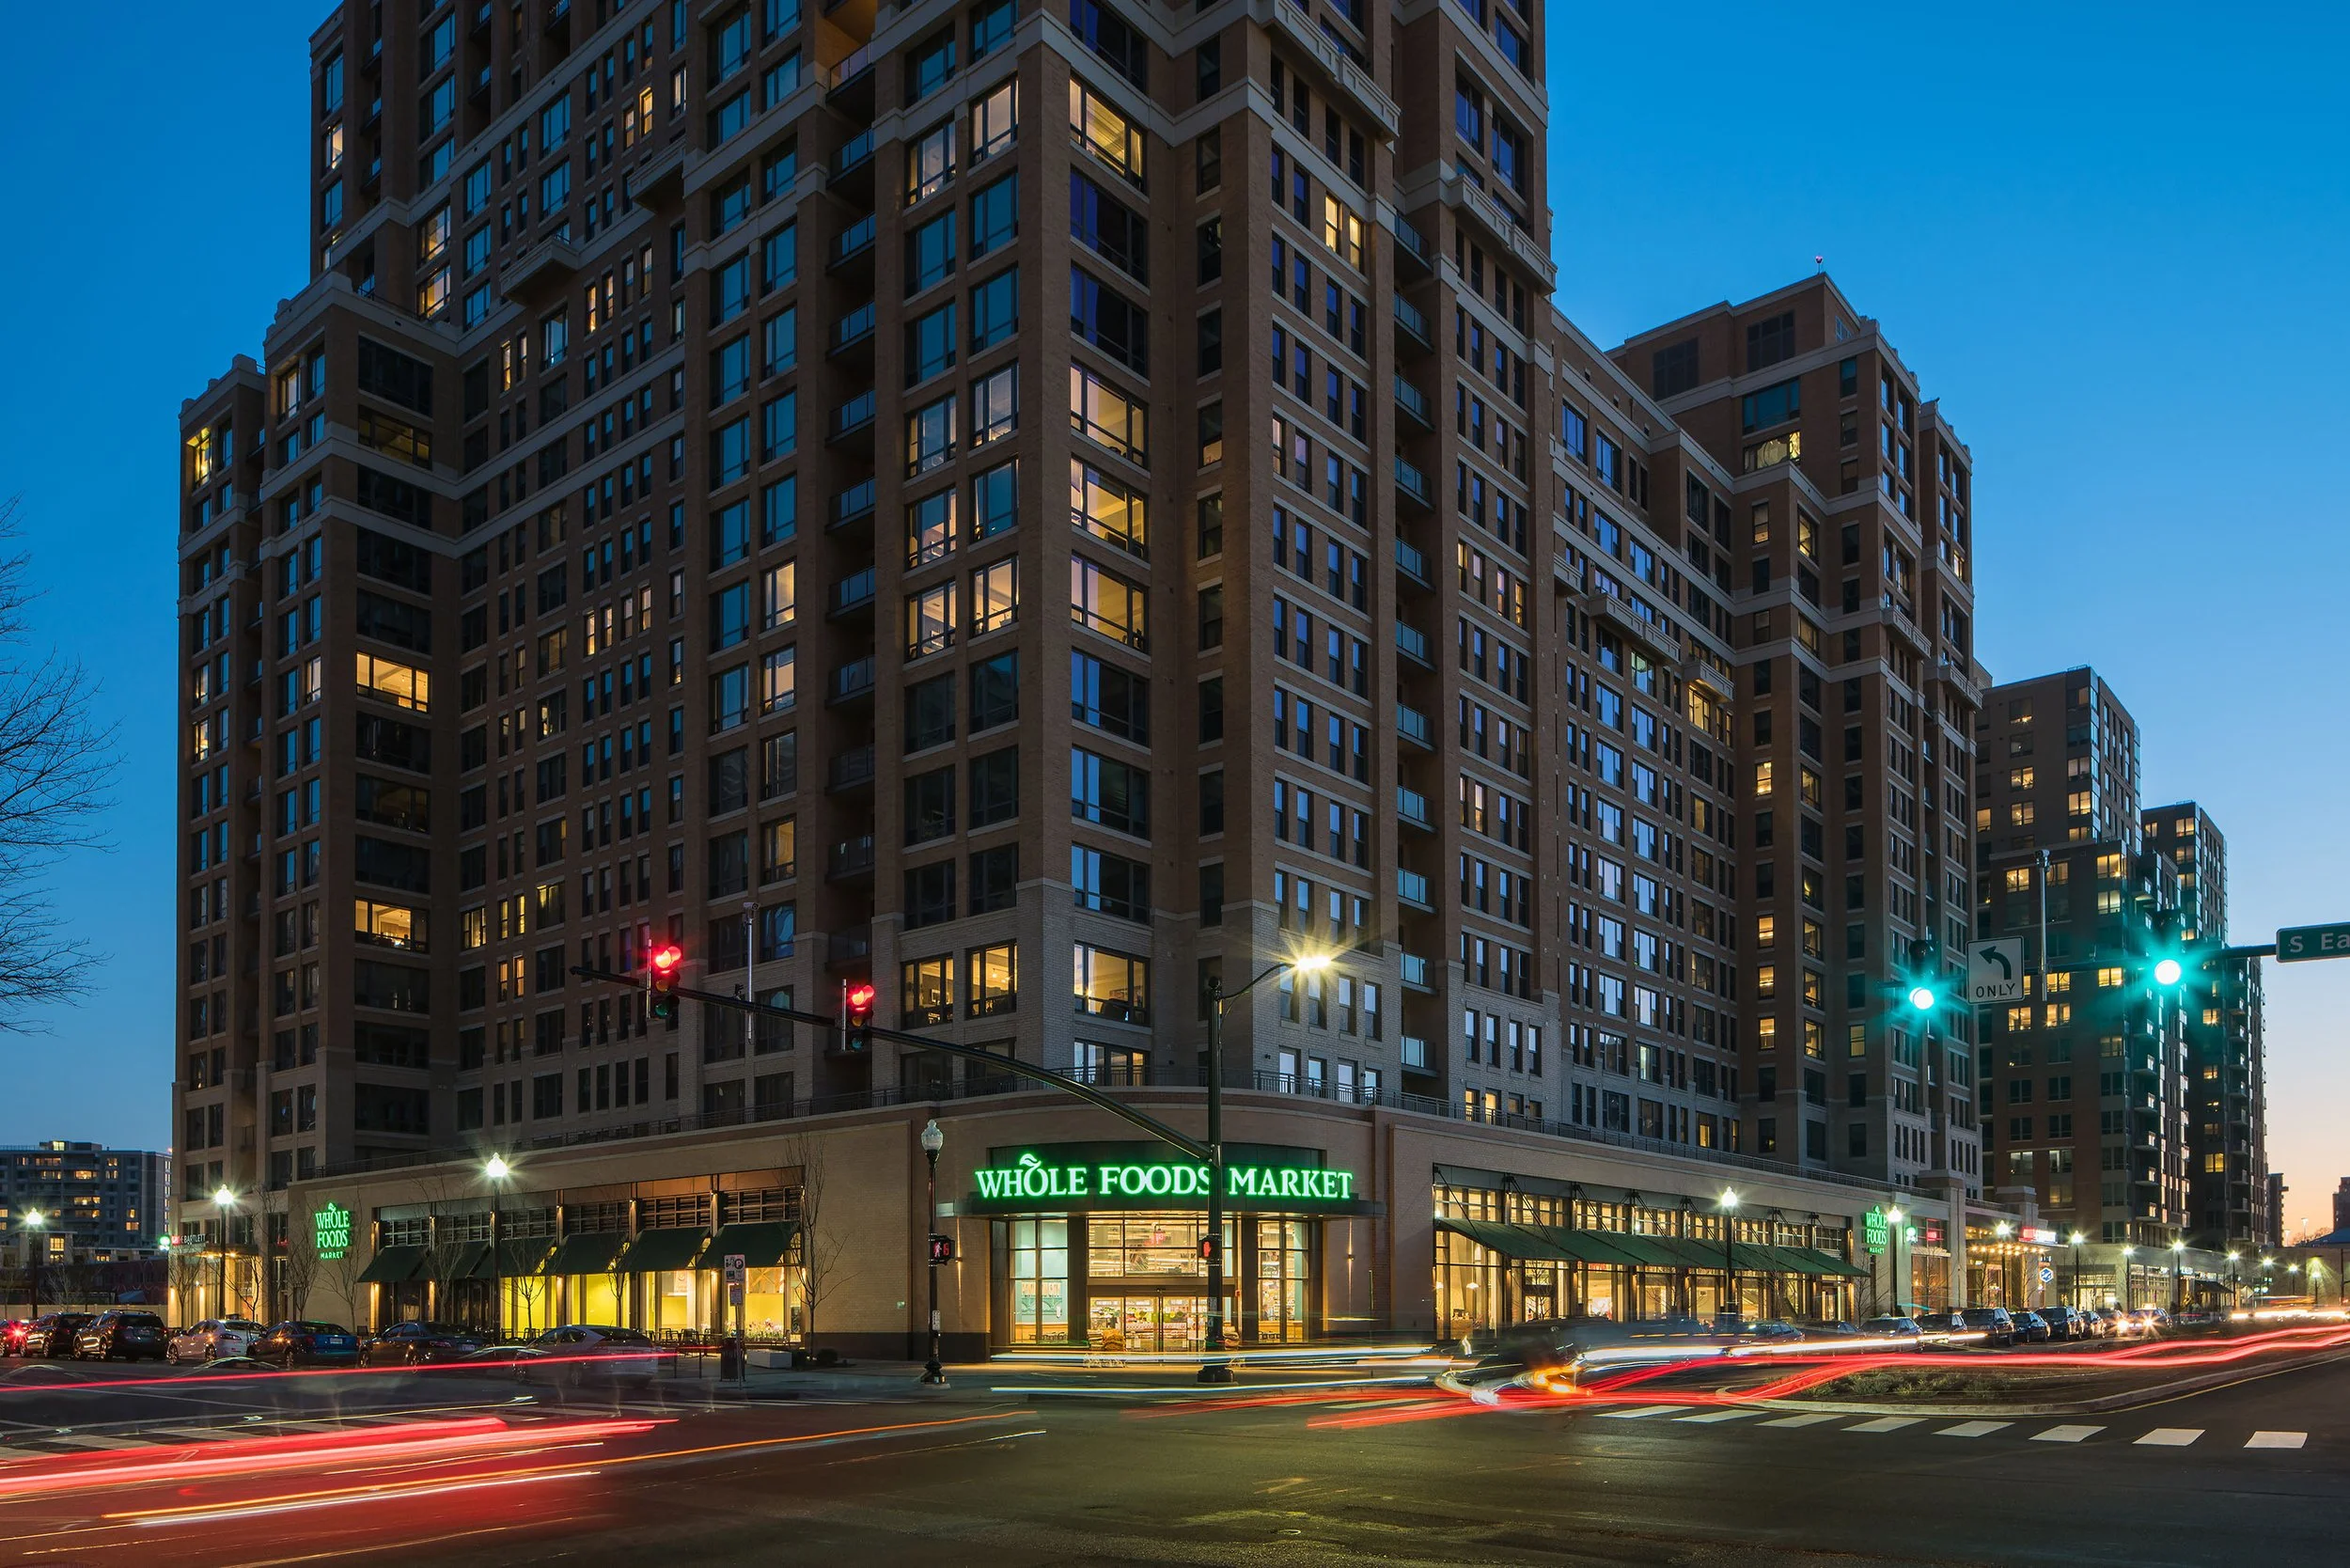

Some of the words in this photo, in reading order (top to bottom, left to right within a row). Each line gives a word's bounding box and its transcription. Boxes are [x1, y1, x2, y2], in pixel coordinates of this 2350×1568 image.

[2290, 935, 2304, 953] S
[1976, 982, 2016, 998] ONLY
[975, 1165, 1089, 1199] WHOLE
[1099, 1166, 1210, 1195] FOODS
[1229, 1167, 1354, 1200] MARKET
[315, 1209, 350, 1230] WHOLE
[1866, 1211, 1888, 1229] WHOLE
[183, 1233, 206, 1244] BARTLETT
[317, 1230, 349, 1248] FOODS
[1866, 1229, 1888, 1246] FOODS
[321, 1250, 344, 1260] MARKET
